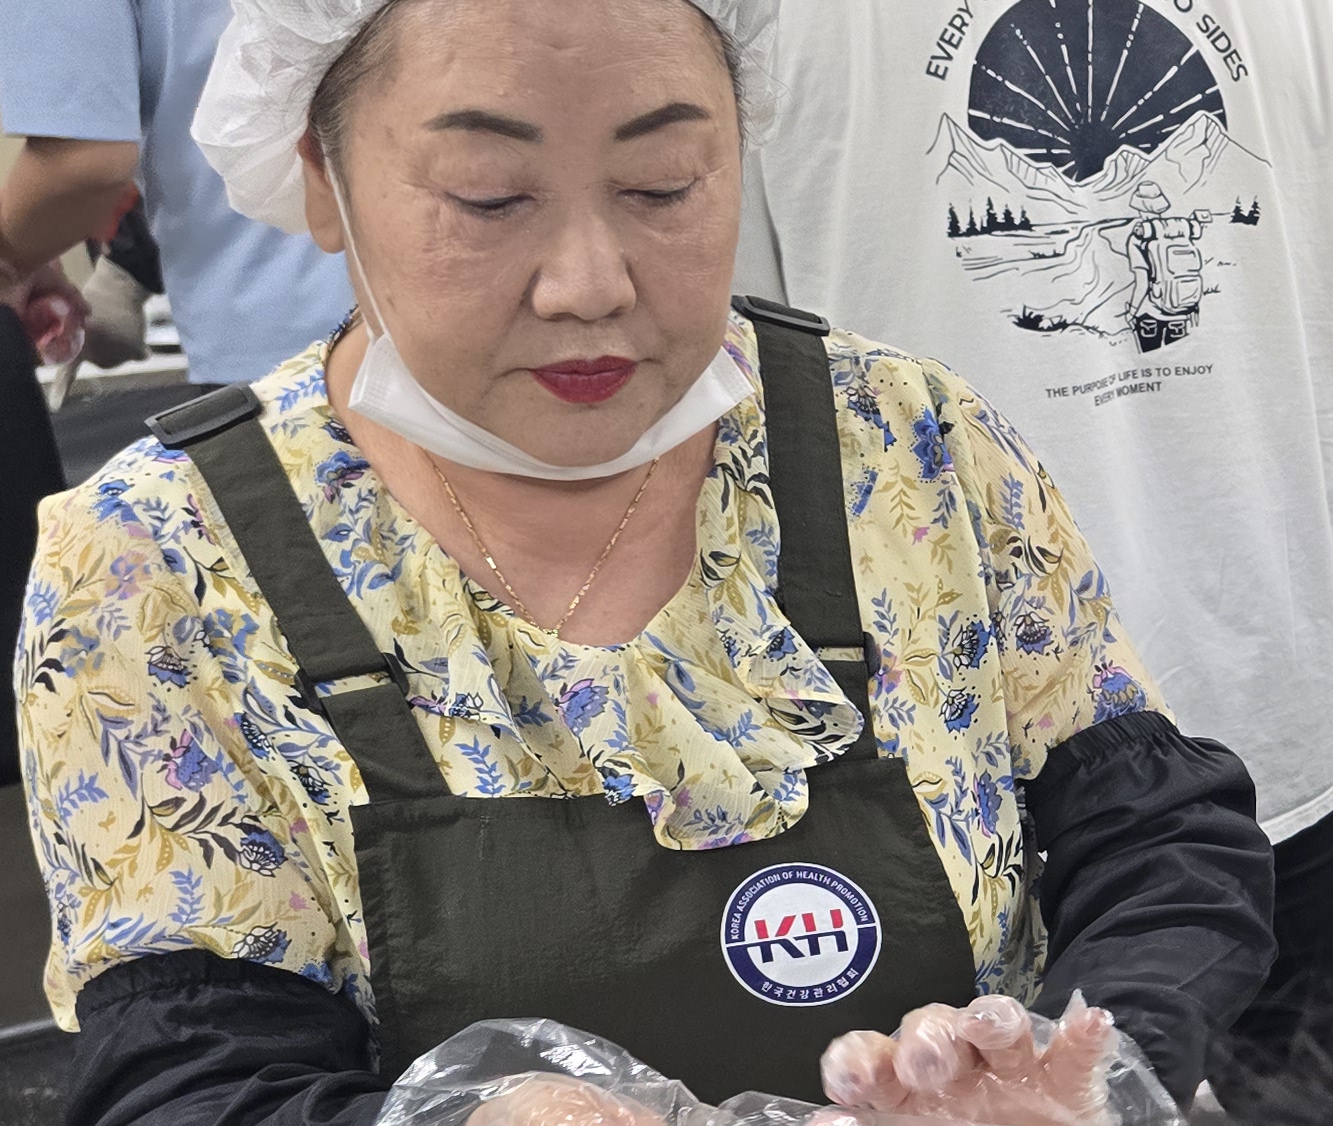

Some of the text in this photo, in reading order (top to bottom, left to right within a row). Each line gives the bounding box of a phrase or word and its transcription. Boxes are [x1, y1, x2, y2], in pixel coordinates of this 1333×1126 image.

[926, 0, 973, 81] EVERY
[1196, 14, 1248, 82] SIDES
[1045, 365, 1213, 399] THE PURPOSE OF LIFE IS TO ENJOY
[1094, 381, 1162, 406] EVERY MOMENT
[730, 871, 869, 940] KOREA ASSOCIATION OF HEALTH PROMOTION
[752, 908, 849, 964] KH
[761, 968, 860, 1000] 한국건강관리협회
